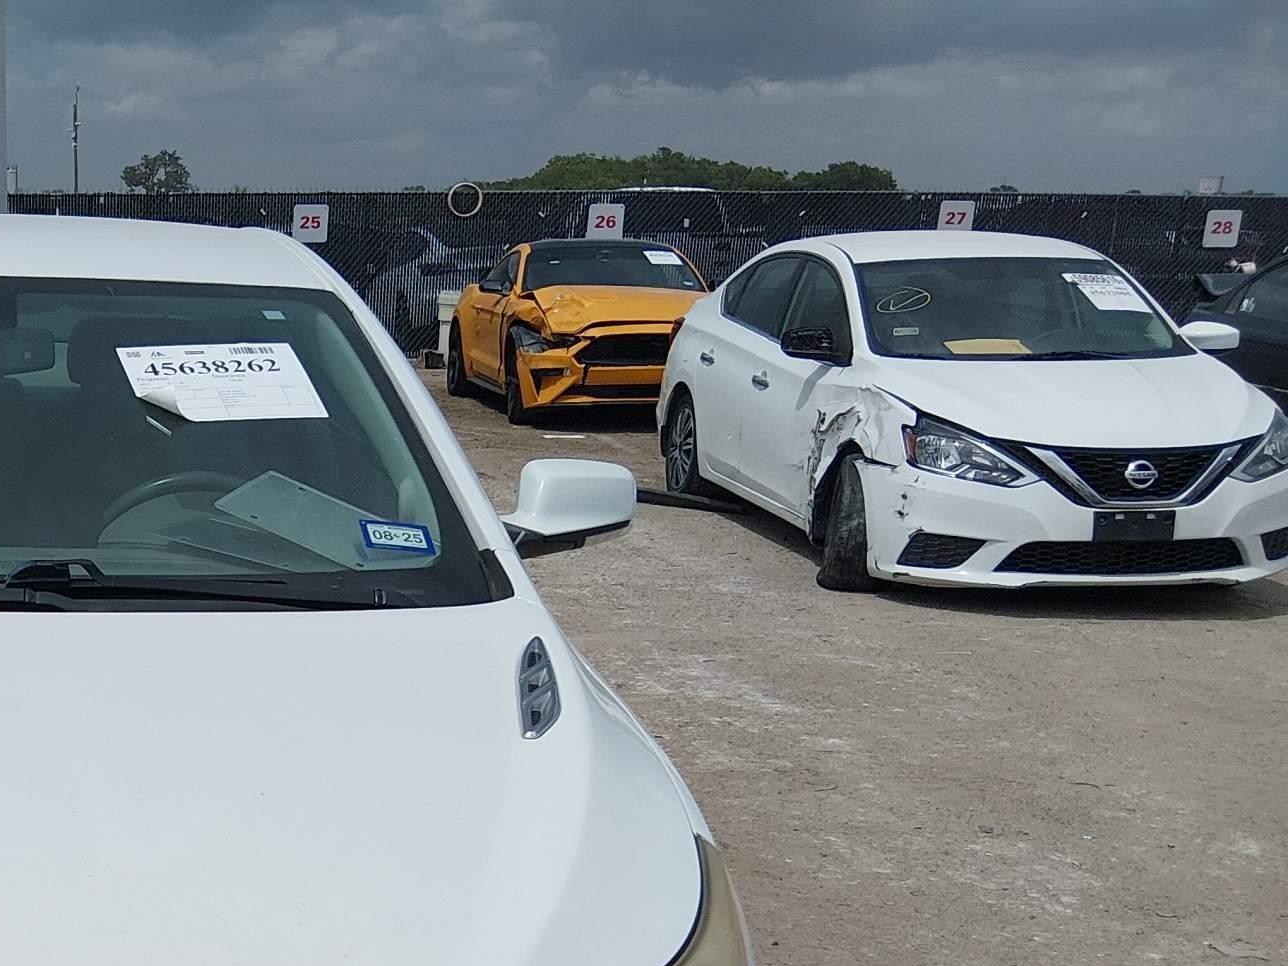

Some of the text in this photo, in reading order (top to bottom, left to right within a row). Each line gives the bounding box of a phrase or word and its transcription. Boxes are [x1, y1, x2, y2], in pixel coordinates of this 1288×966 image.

[299, 215, 322, 230] 25
[594, 215, 617, 230] 26
[945, 211, 967, 226] 27
[1211, 220, 1233, 235] 28
[143, 358, 281, 377] 45638262
